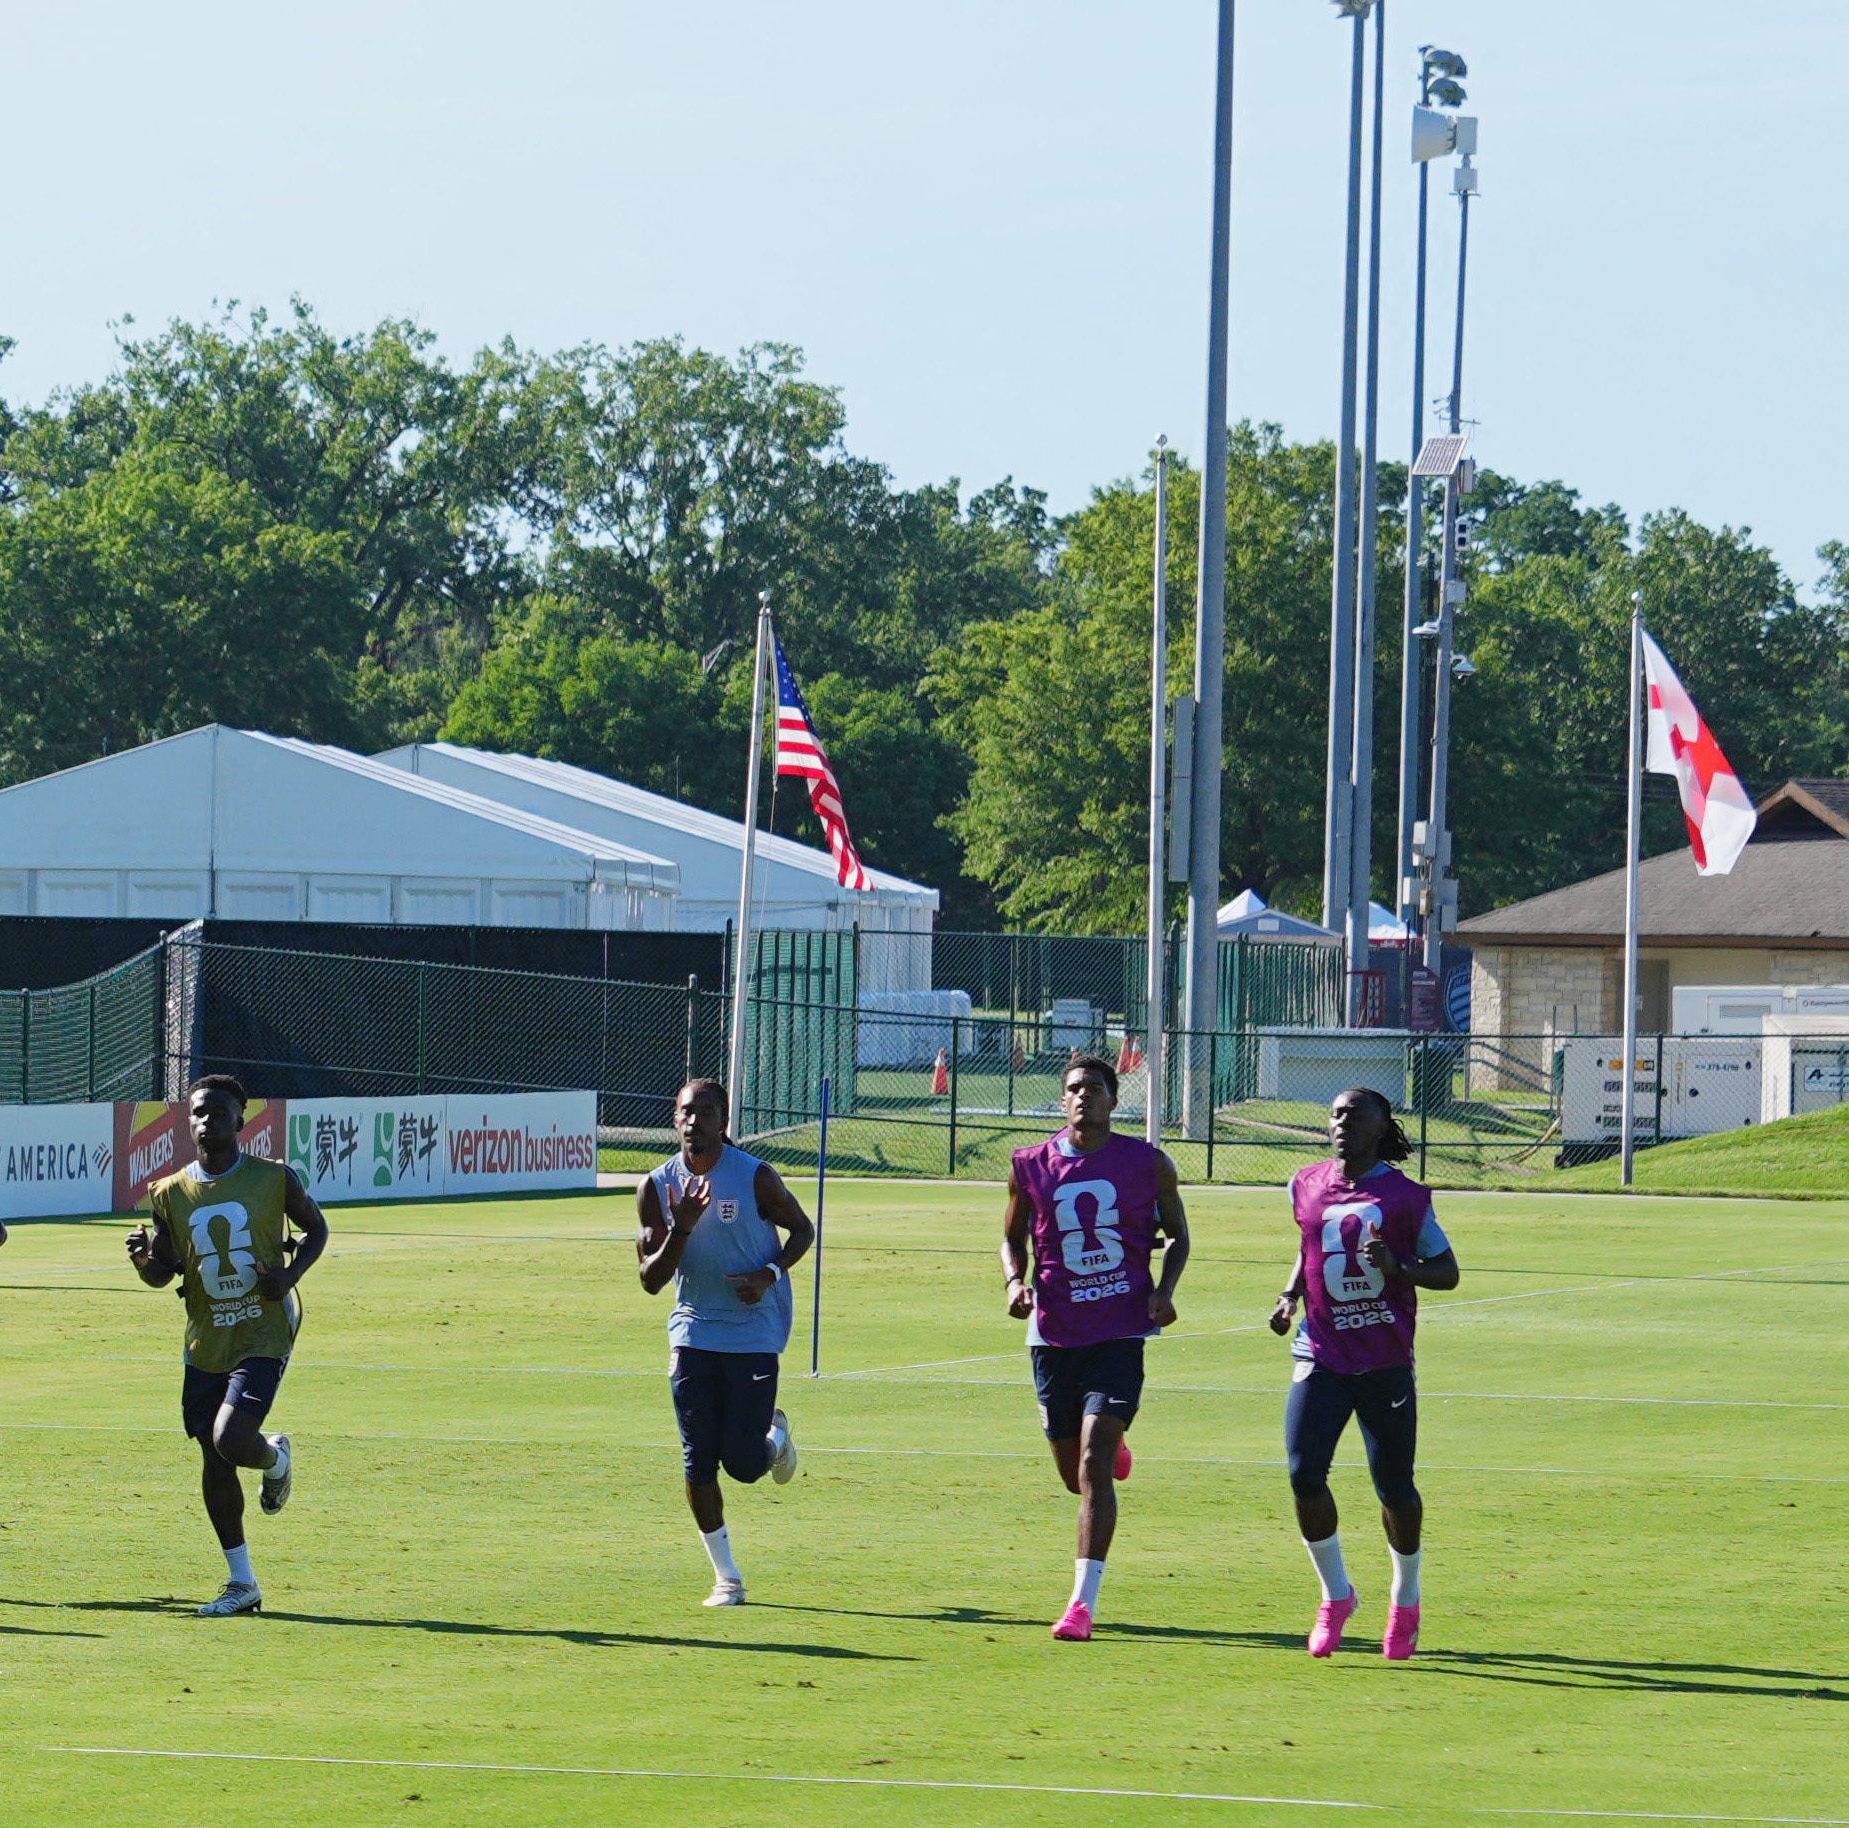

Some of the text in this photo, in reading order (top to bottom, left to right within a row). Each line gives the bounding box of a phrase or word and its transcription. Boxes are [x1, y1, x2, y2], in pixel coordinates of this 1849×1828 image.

[316, 1112, 358, 1186] 蒙牛
[398, 1111, 439, 1183] 蒙牛
[449, 1114, 593, 1175] verizon business
[6, 1142, 89, 1182] AMERICA
[129, 1128, 174, 1189] WALKERS
[1082, 1254, 1110, 1266] FIFA
[218, 1279, 244, 1291] FIFA
[1068, 1270, 1127, 1288] WORLD CUP
[1342, 1281, 1372, 1292] FIFA
[1070, 1280, 1131, 1303] 2026
[1330, 1302, 1370, 1315] WORLD
[1333, 1310, 1396, 1331] 2026
